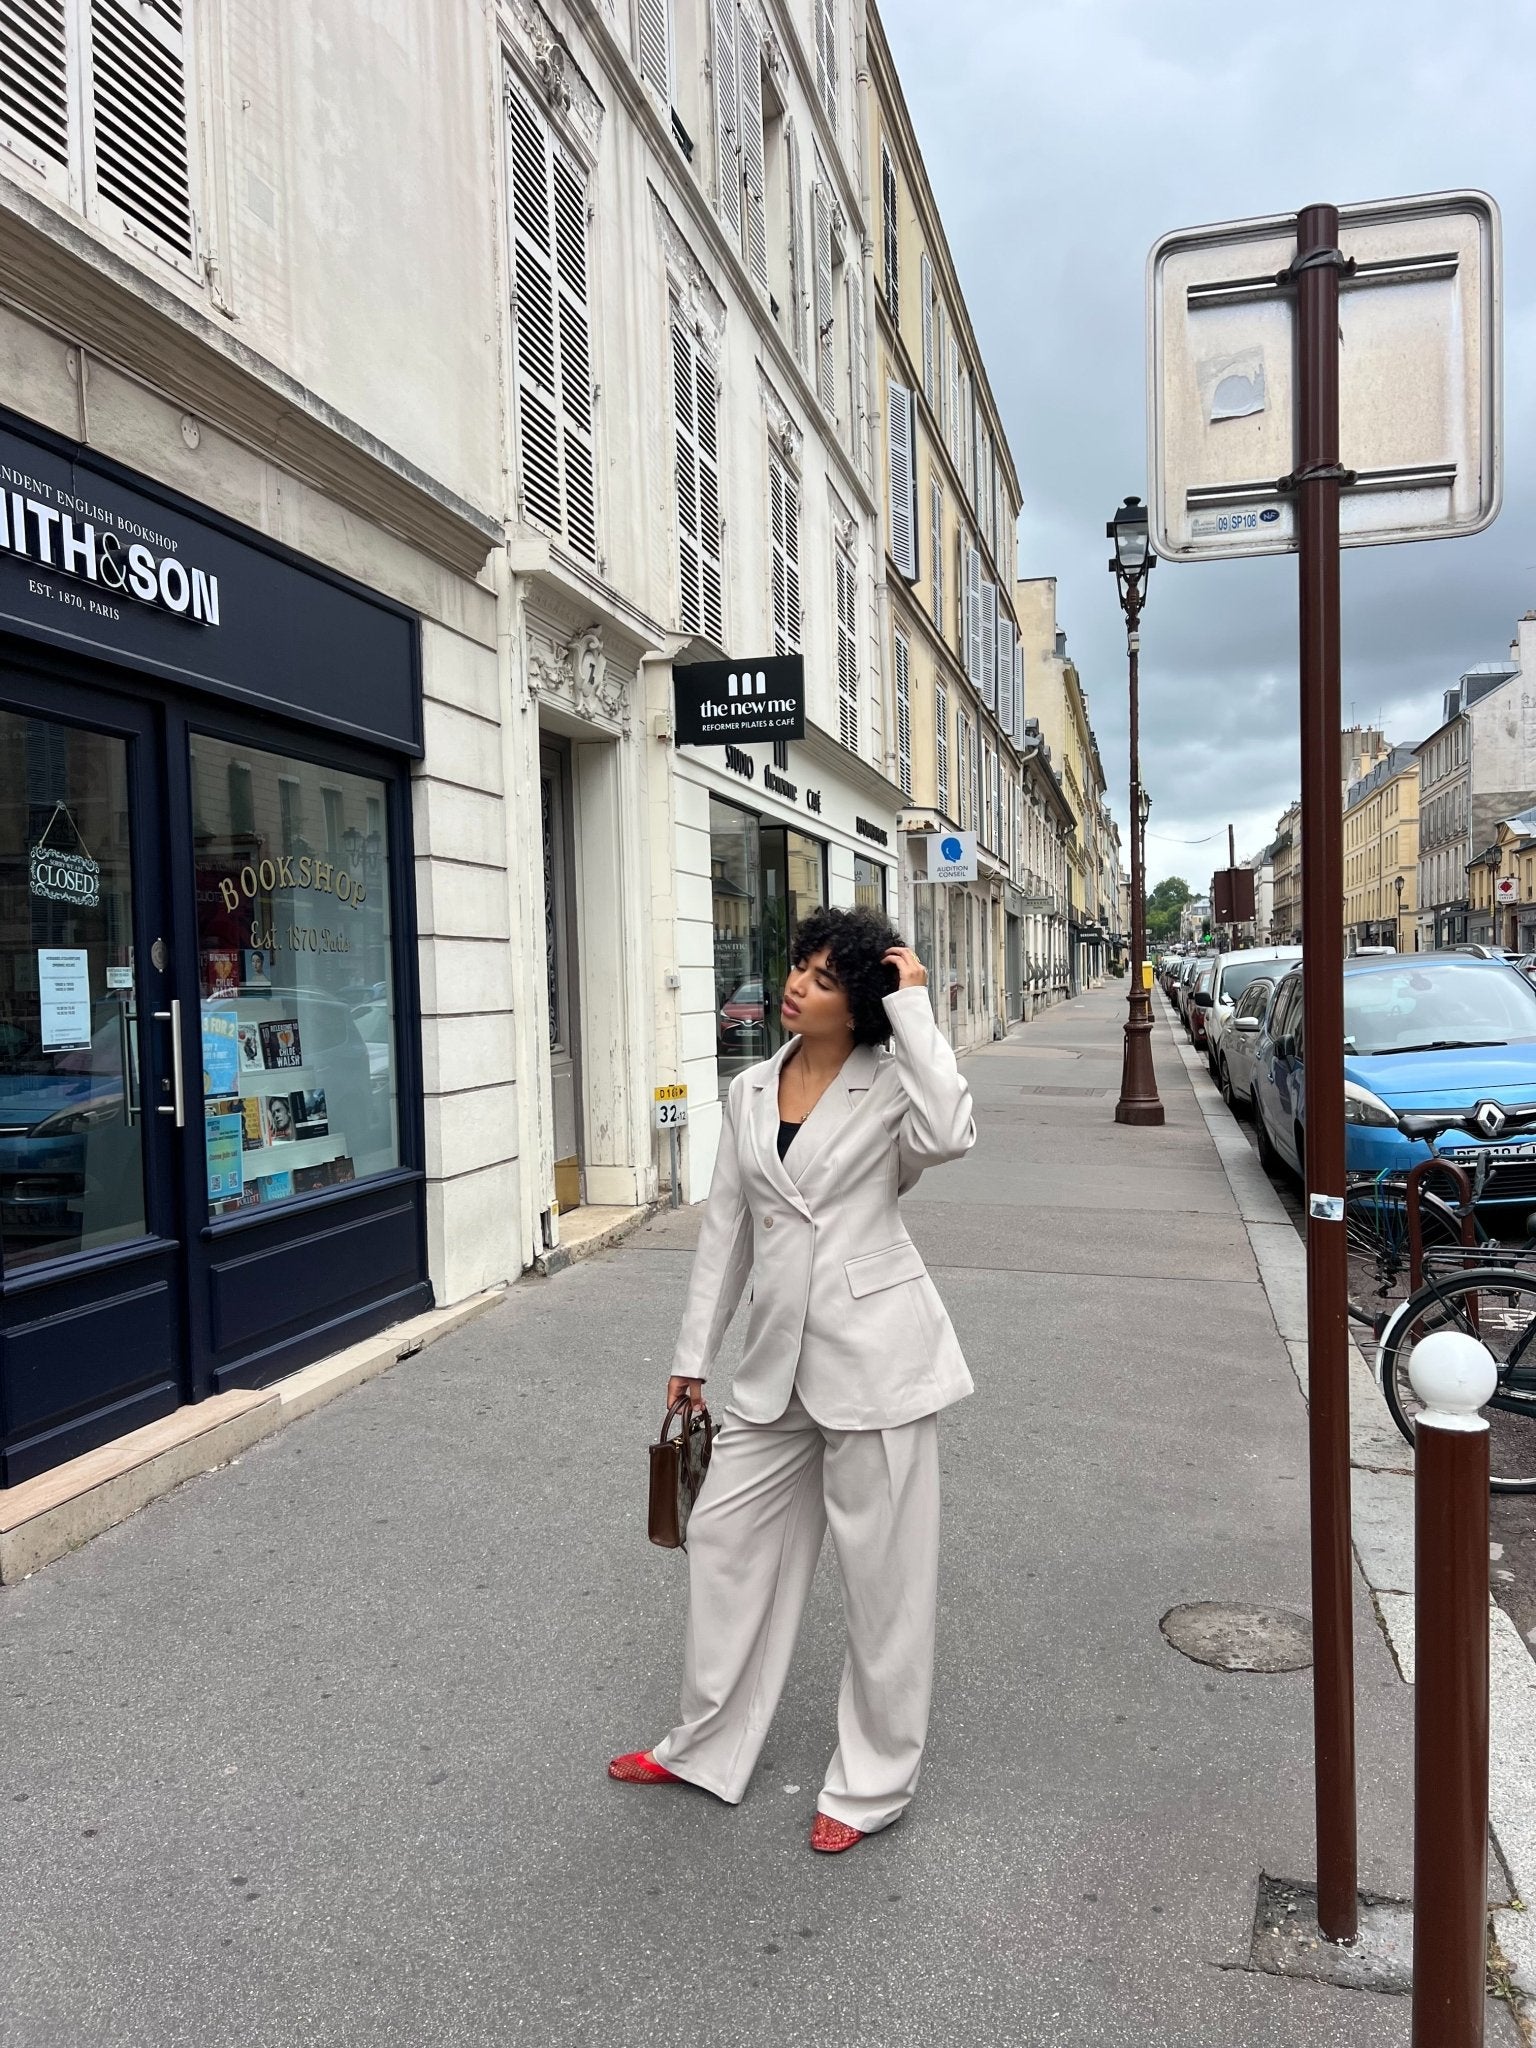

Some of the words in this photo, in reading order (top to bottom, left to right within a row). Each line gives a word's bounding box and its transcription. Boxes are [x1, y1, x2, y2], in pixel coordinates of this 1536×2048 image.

[0, 464, 53, 498] NDENT
[56, 489, 114, 526] ENGLISH
[117, 515, 179, 553] BOOKSHOP
[29, 579, 54, 599] EST.
[59, 590, 86, 611] 1870,
[89, 600, 120, 621] PARIS
[700, 700, 728, 718] the
[730, 700, 767, 716] new
[767, 698, 796, 713] me
[702, 722, 740, 732] REFORMER
[741, 719, 768, 730] PILATES
[768, 719, 775, 727] &
[775, 717, 795, 727] CAFÉ
[36, 863, 95, 894] CLOSED
[218, 855, 367, 914] BOOKSHOP
[250, 920, 283, 950] Est.
[276, 1055, 300, 1067] WALSH
